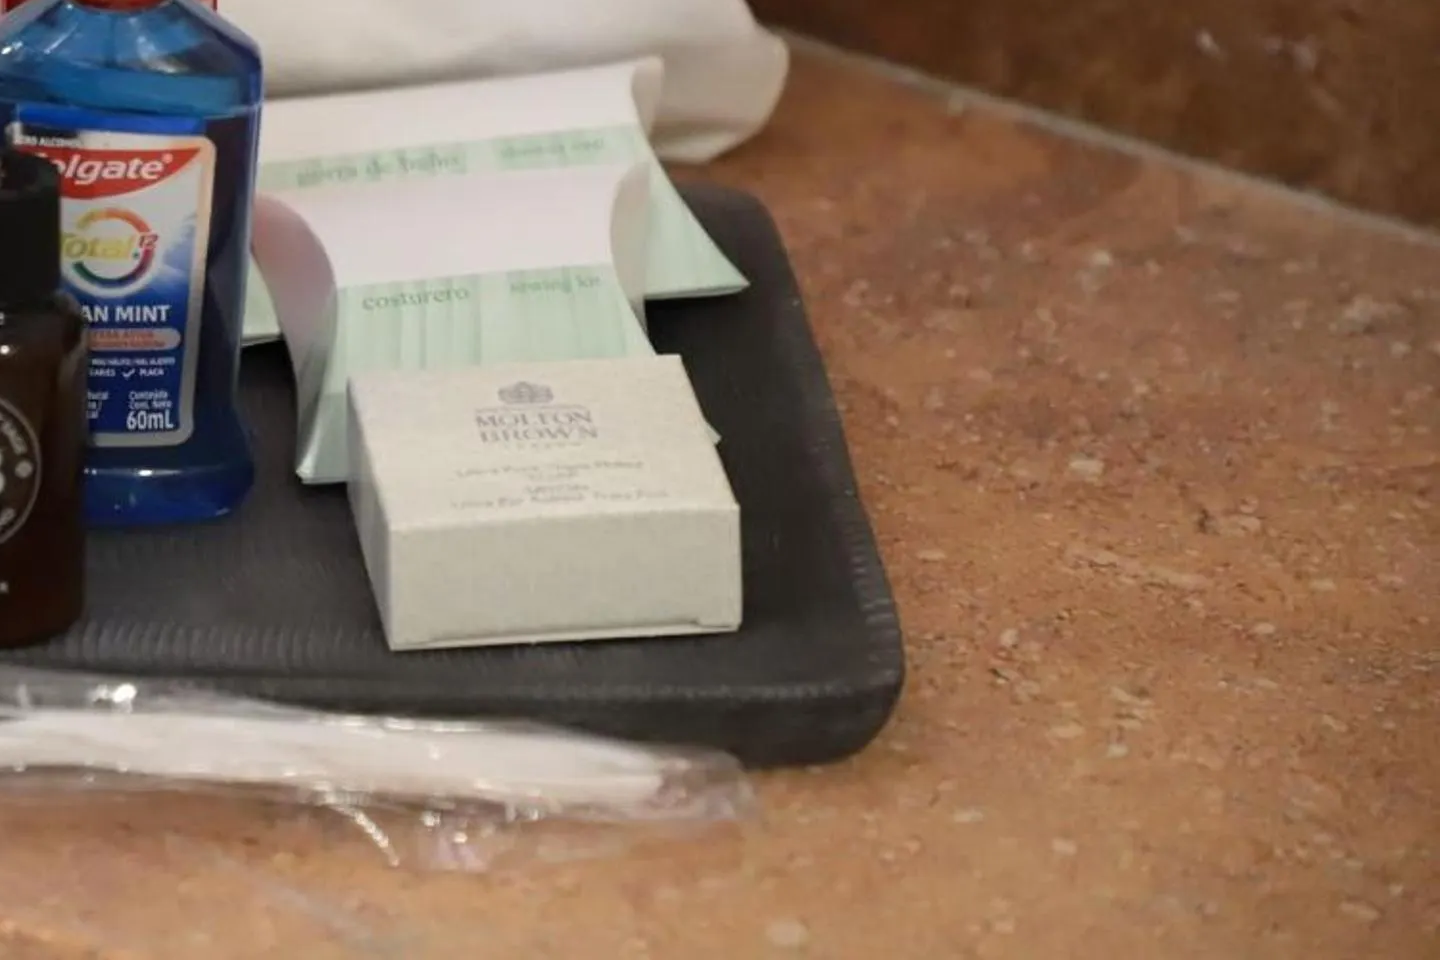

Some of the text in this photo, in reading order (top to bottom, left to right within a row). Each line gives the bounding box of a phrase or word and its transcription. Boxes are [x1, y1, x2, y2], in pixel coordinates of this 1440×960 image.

[35, 152, 165, 186] lgate
[115, 305, 171, 323] MINT
[126, 409, 174, 430] 60mL
